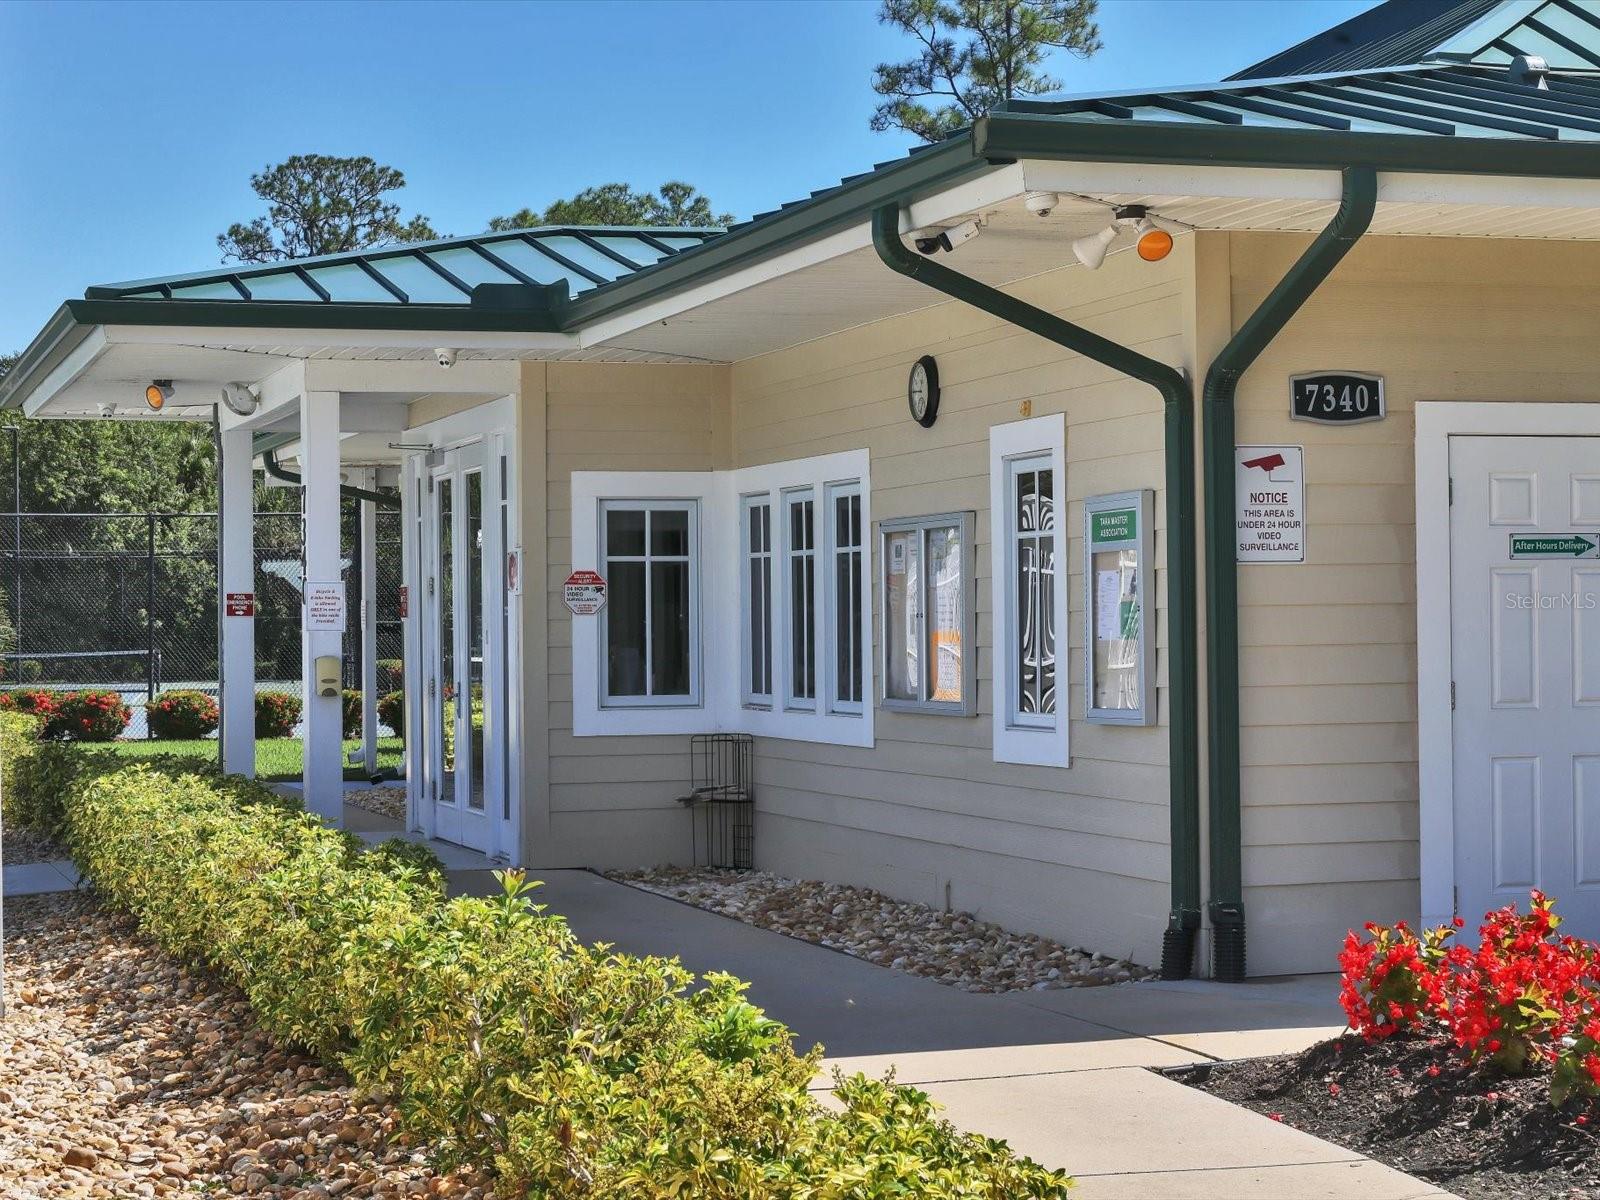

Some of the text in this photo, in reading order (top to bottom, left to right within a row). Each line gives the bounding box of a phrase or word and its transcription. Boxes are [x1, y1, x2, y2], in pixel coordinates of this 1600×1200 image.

[1305, 384, 1369, 412] 7340
[1250, 492, 1288, 503] NOTICE
[1244, 509, 1295, 518] THIS AREA IS
[1237, 520, 1301, 529] UNDER 24 HOUR
[1257, 531, 1281, 540] VIDEO
[1240, 543, 1299, 551] SURVEILLANCE
[1515, 540, 1589, 551] After Hours Delivery
